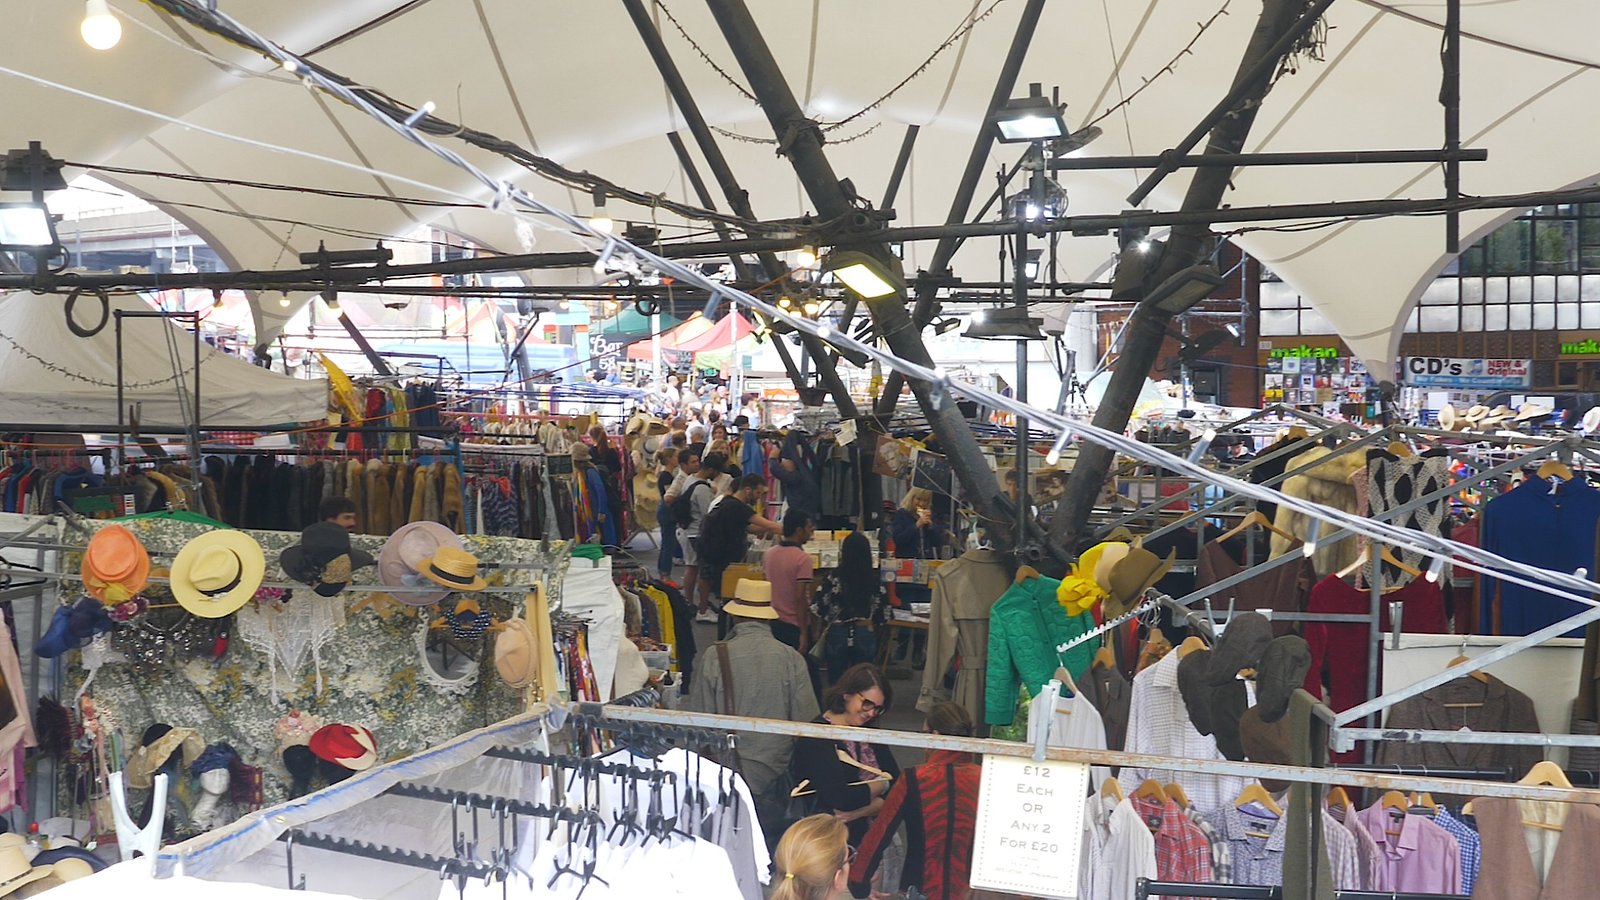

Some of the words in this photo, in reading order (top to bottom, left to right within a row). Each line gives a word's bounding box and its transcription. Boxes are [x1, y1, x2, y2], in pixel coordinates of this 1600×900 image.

[590, 335, 623, 356] Bar
[1270, 344, 1338, 358] makan
[1561, 339, 1600, 354] mak
[599, 356, 616, 370] 58
[1409, 357, 1462, 376] CD's
[1487, 360, 1511, 368] NEW
[1487, 367, 1527, 377] Original
[1023, 765, 1050, 778] £12
[1016, 783, 1053, 796] EACH
[1022, 803, 1043, 814] OR
[1010, 820, 1038, 832] ANY
[1042, 824, 1051, 834] 2
[1000, 837, 1027, 849] FOR
[1031, 841, 1058, 853] £20
